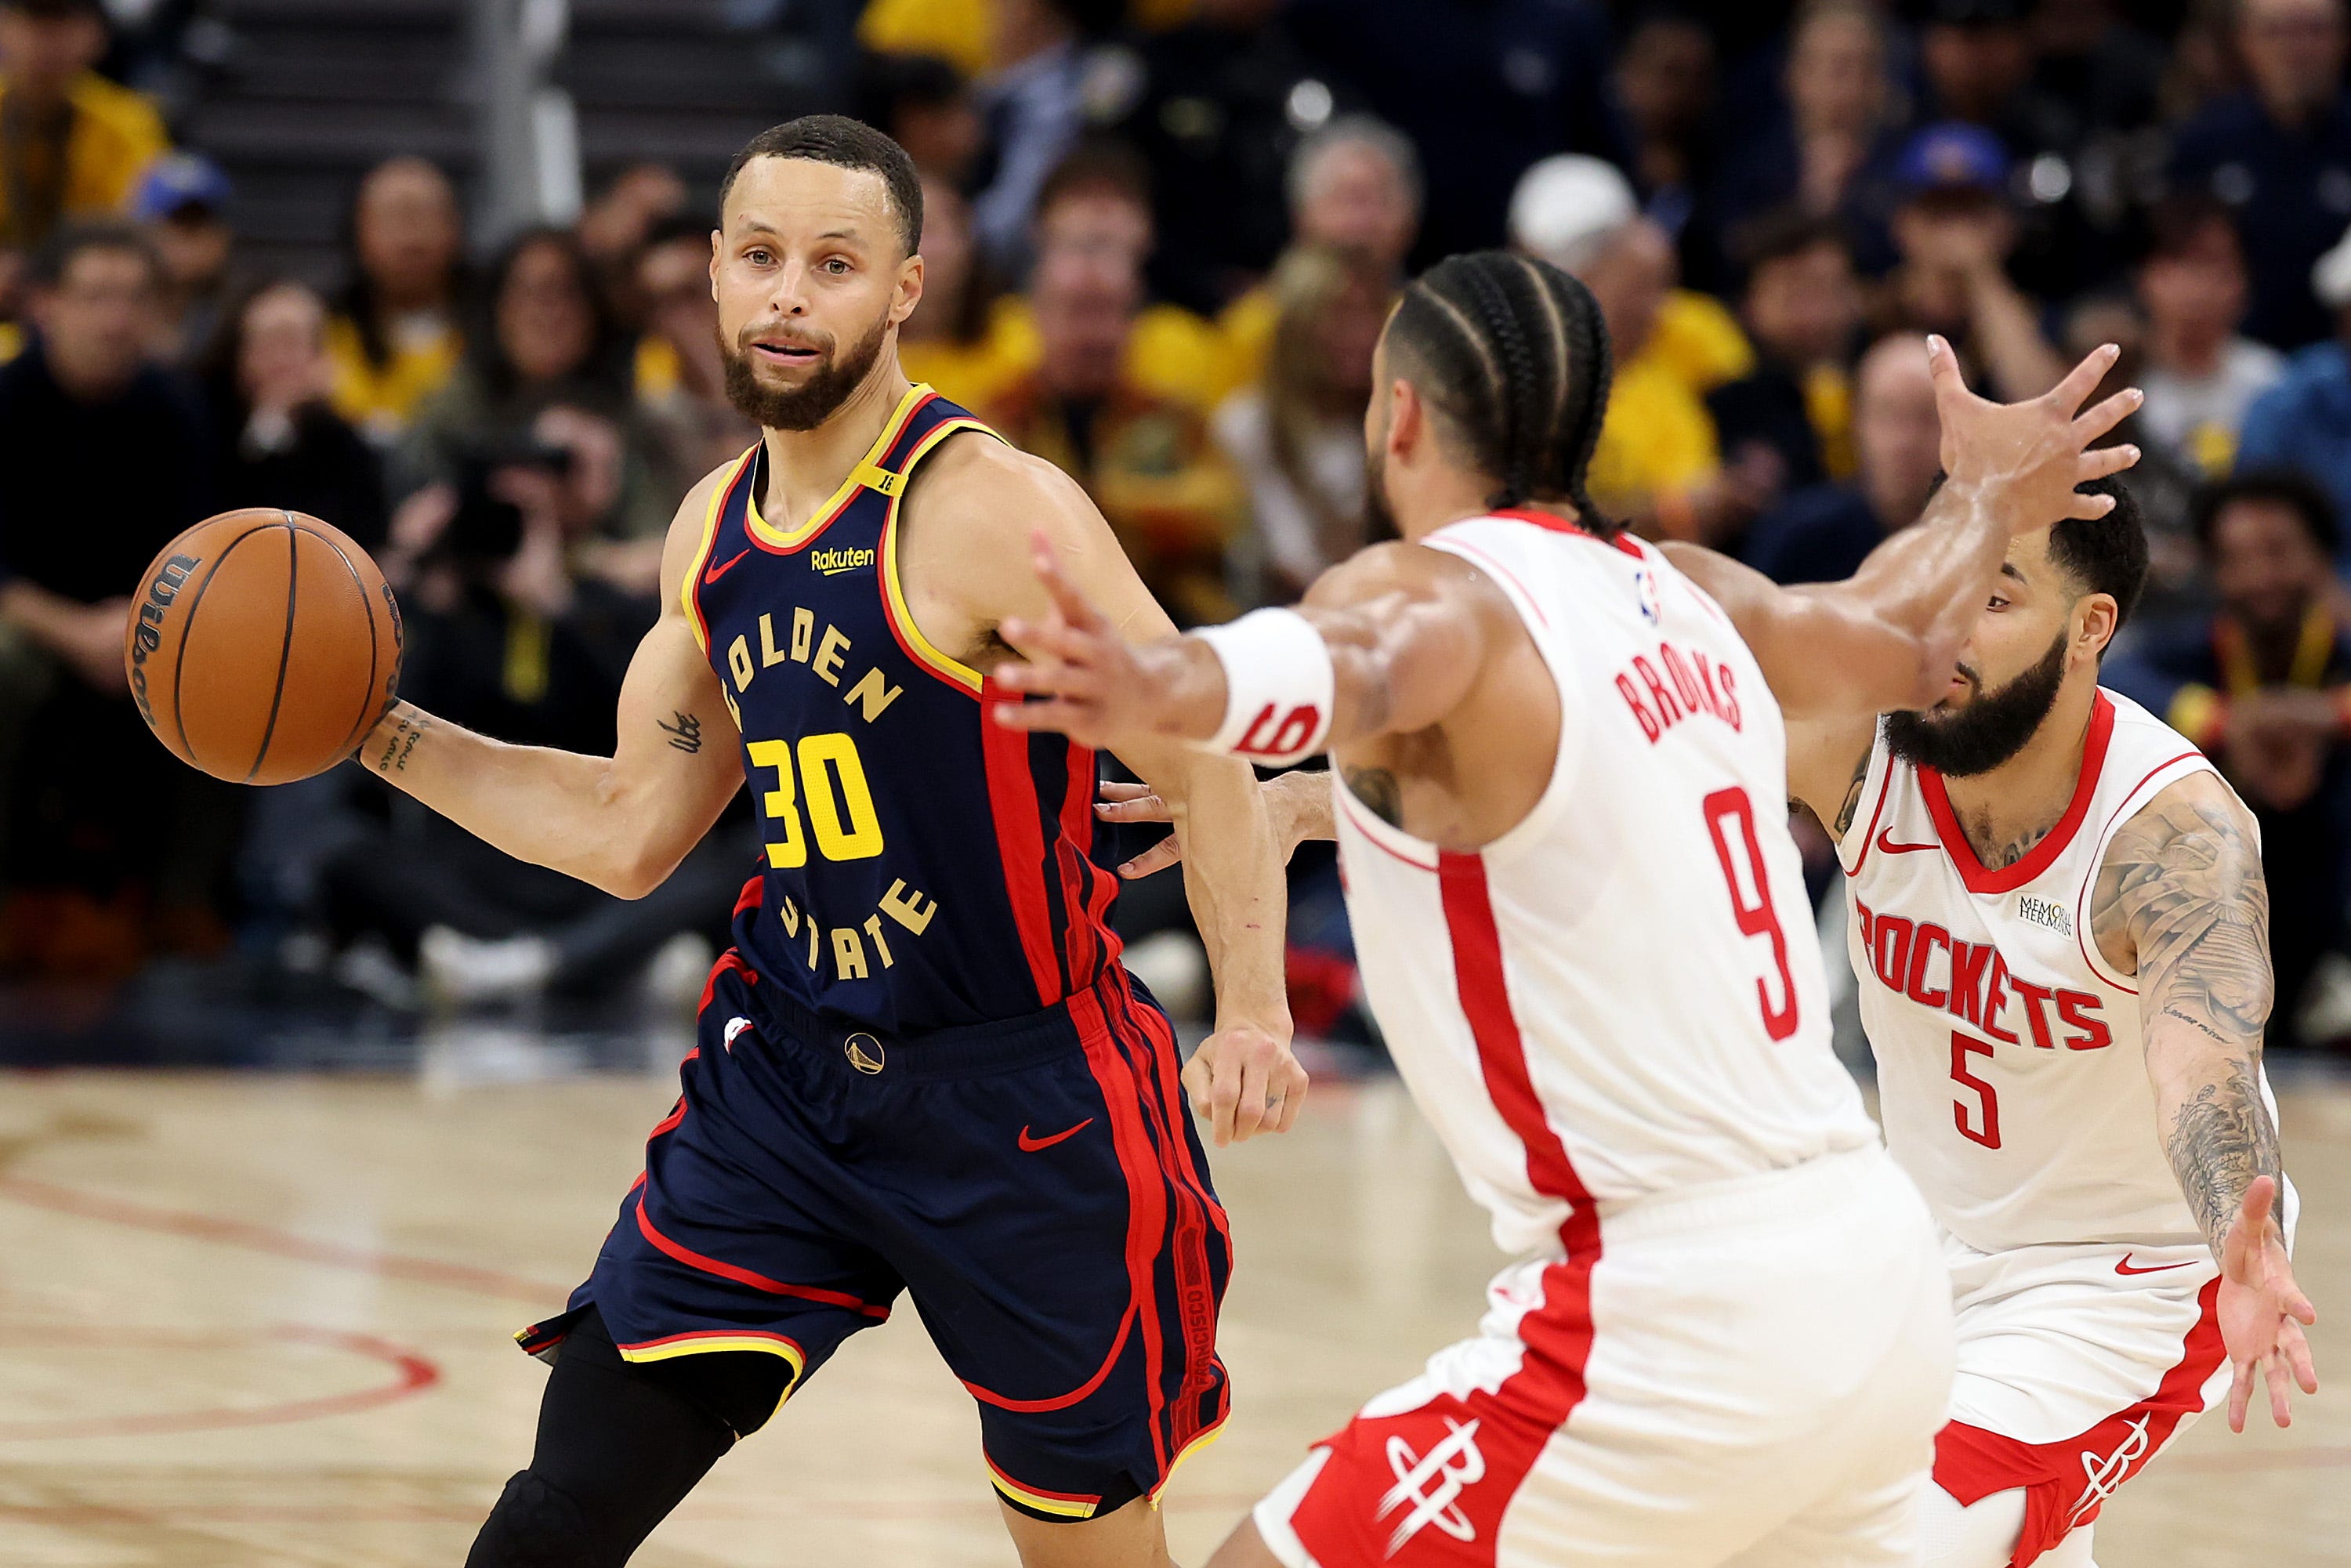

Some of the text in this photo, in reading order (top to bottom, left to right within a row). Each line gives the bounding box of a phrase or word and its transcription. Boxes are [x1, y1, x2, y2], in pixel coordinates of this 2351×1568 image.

[878, 475, 894, 491] 16
[811, 546, 875, 572] Rakuten
[132, 553, 203, 726] Wilson
[1614, 641, 1742, 747] BROKS
[745, 732, 885, 870] 30
[780, 878, 938, 981] STATE
[1702, 785, 1799, 1043] 9
[2020, 896, 2072, 927] MEMOL
[1855, 896, 2114, 1052] ROCKETS
[1950, 1029, 2002, 1150] 5
